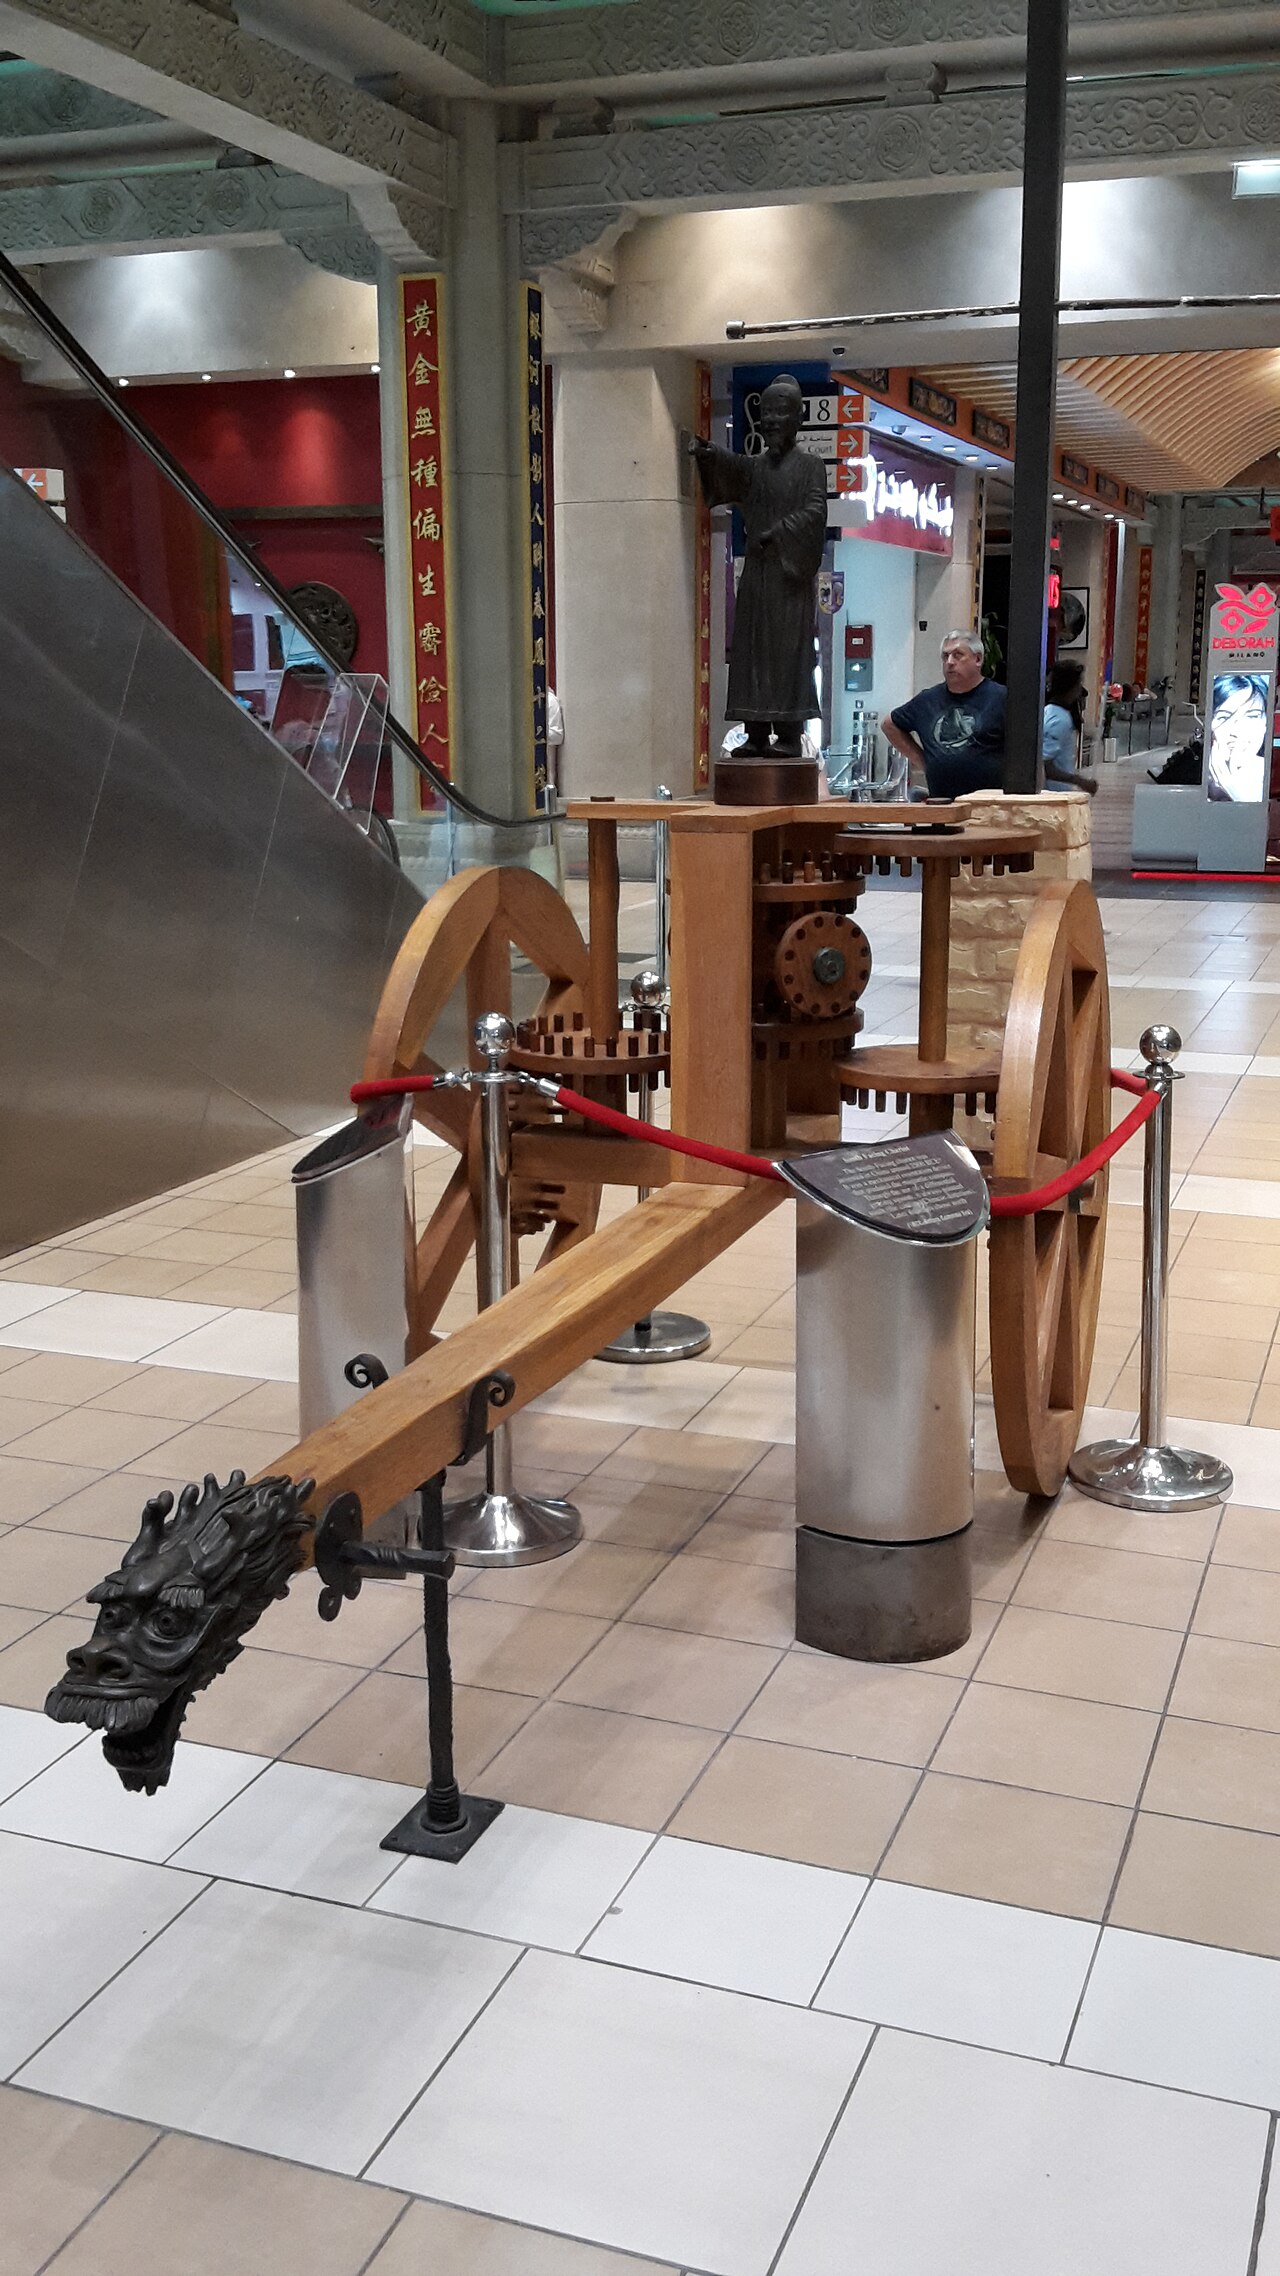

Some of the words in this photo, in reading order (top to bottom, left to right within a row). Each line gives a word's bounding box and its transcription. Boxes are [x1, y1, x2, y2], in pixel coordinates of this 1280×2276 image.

[817, 398, 831, 422] 8
[807, 444, 833, 454] Court
[1212, 636, 1275, 650] DEBORAH
